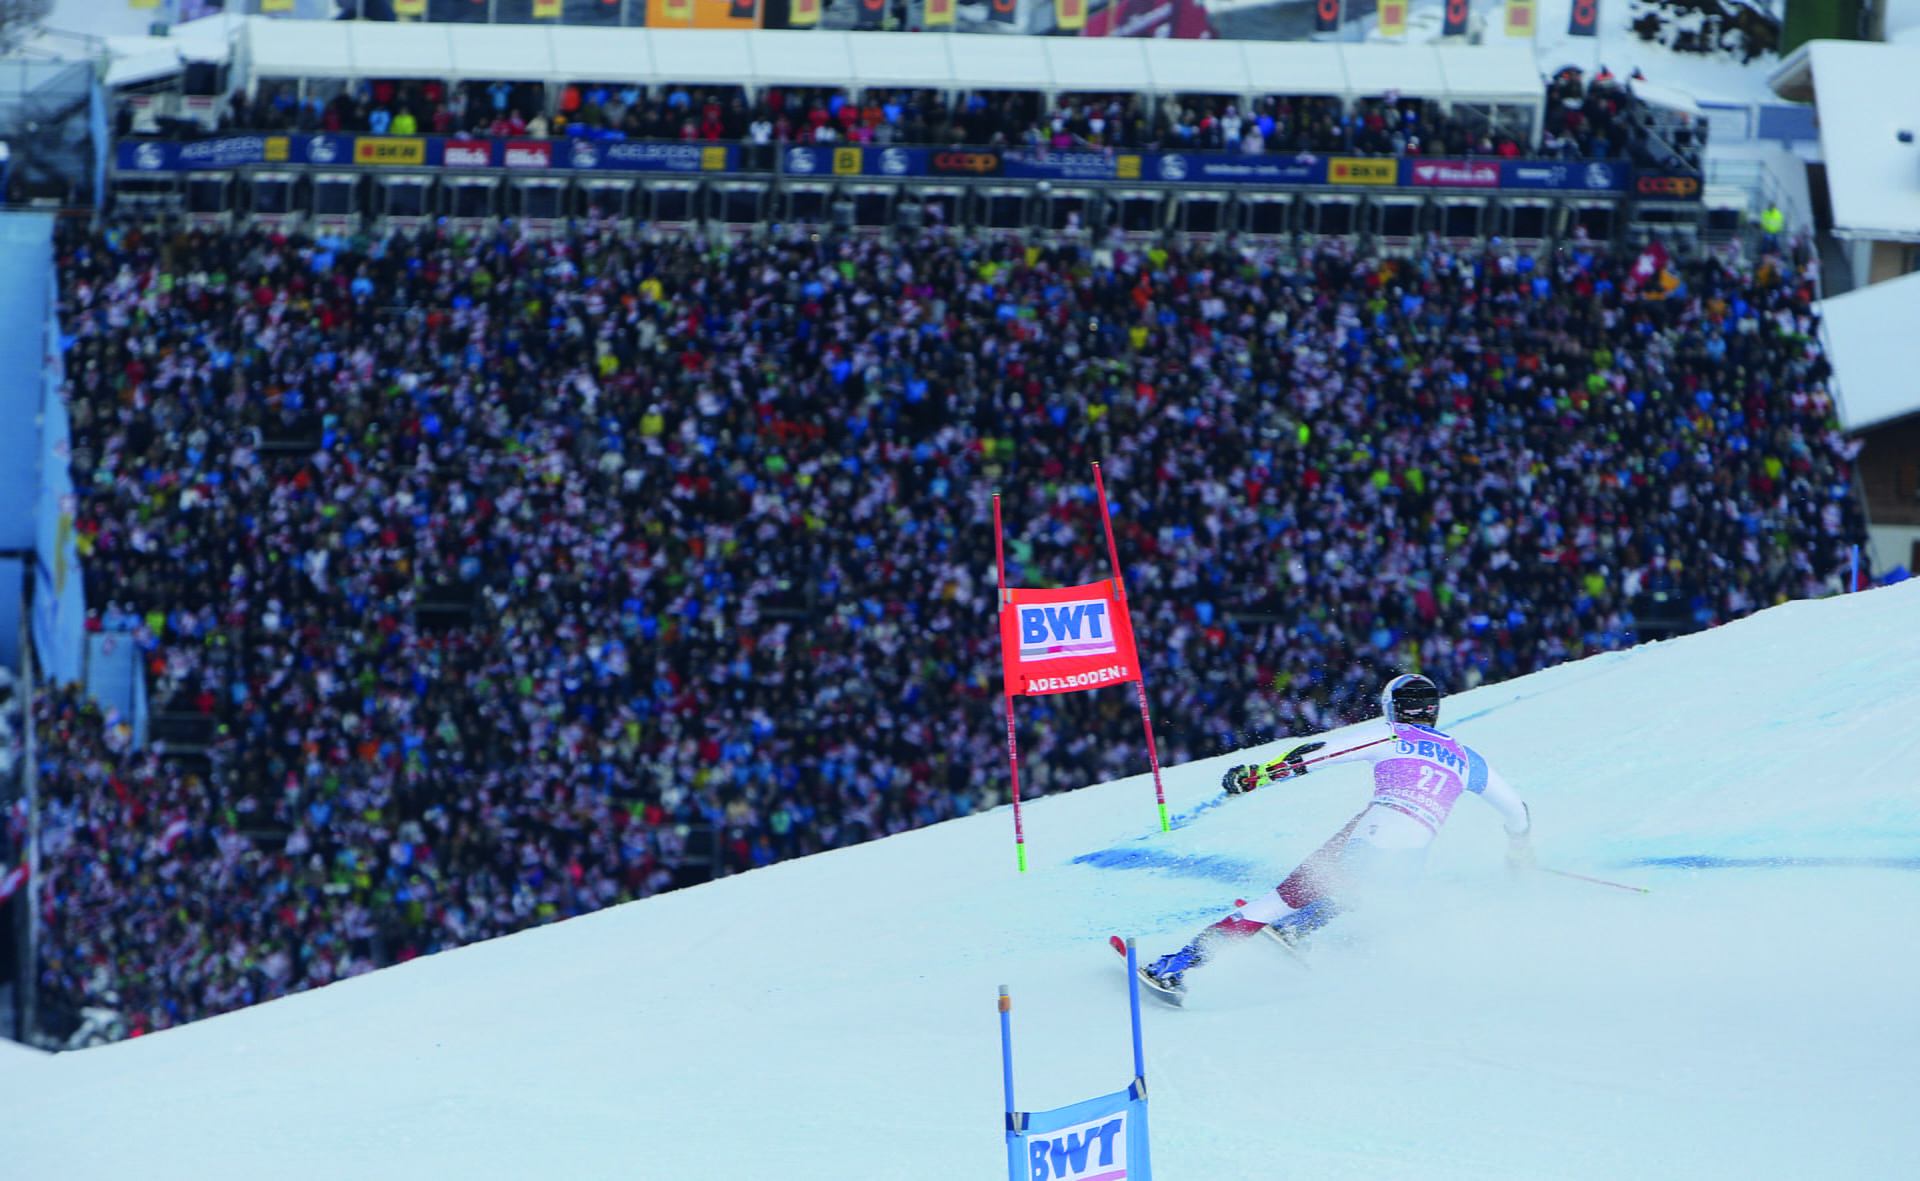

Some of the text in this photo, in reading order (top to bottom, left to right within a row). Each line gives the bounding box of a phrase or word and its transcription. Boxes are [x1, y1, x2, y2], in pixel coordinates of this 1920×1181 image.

[934, 152, 998, 174] coop
[1636, 176, 1698, 197] coop
[1021, 603, 1105, 644] BWT
[1027, 665, 1120, 693] ADELBODEN
[1418, 740, 1466, 776] BWT
[1417, 765, 1449, 796] 27
[1029, 1118, 1123, 1181] BWT
